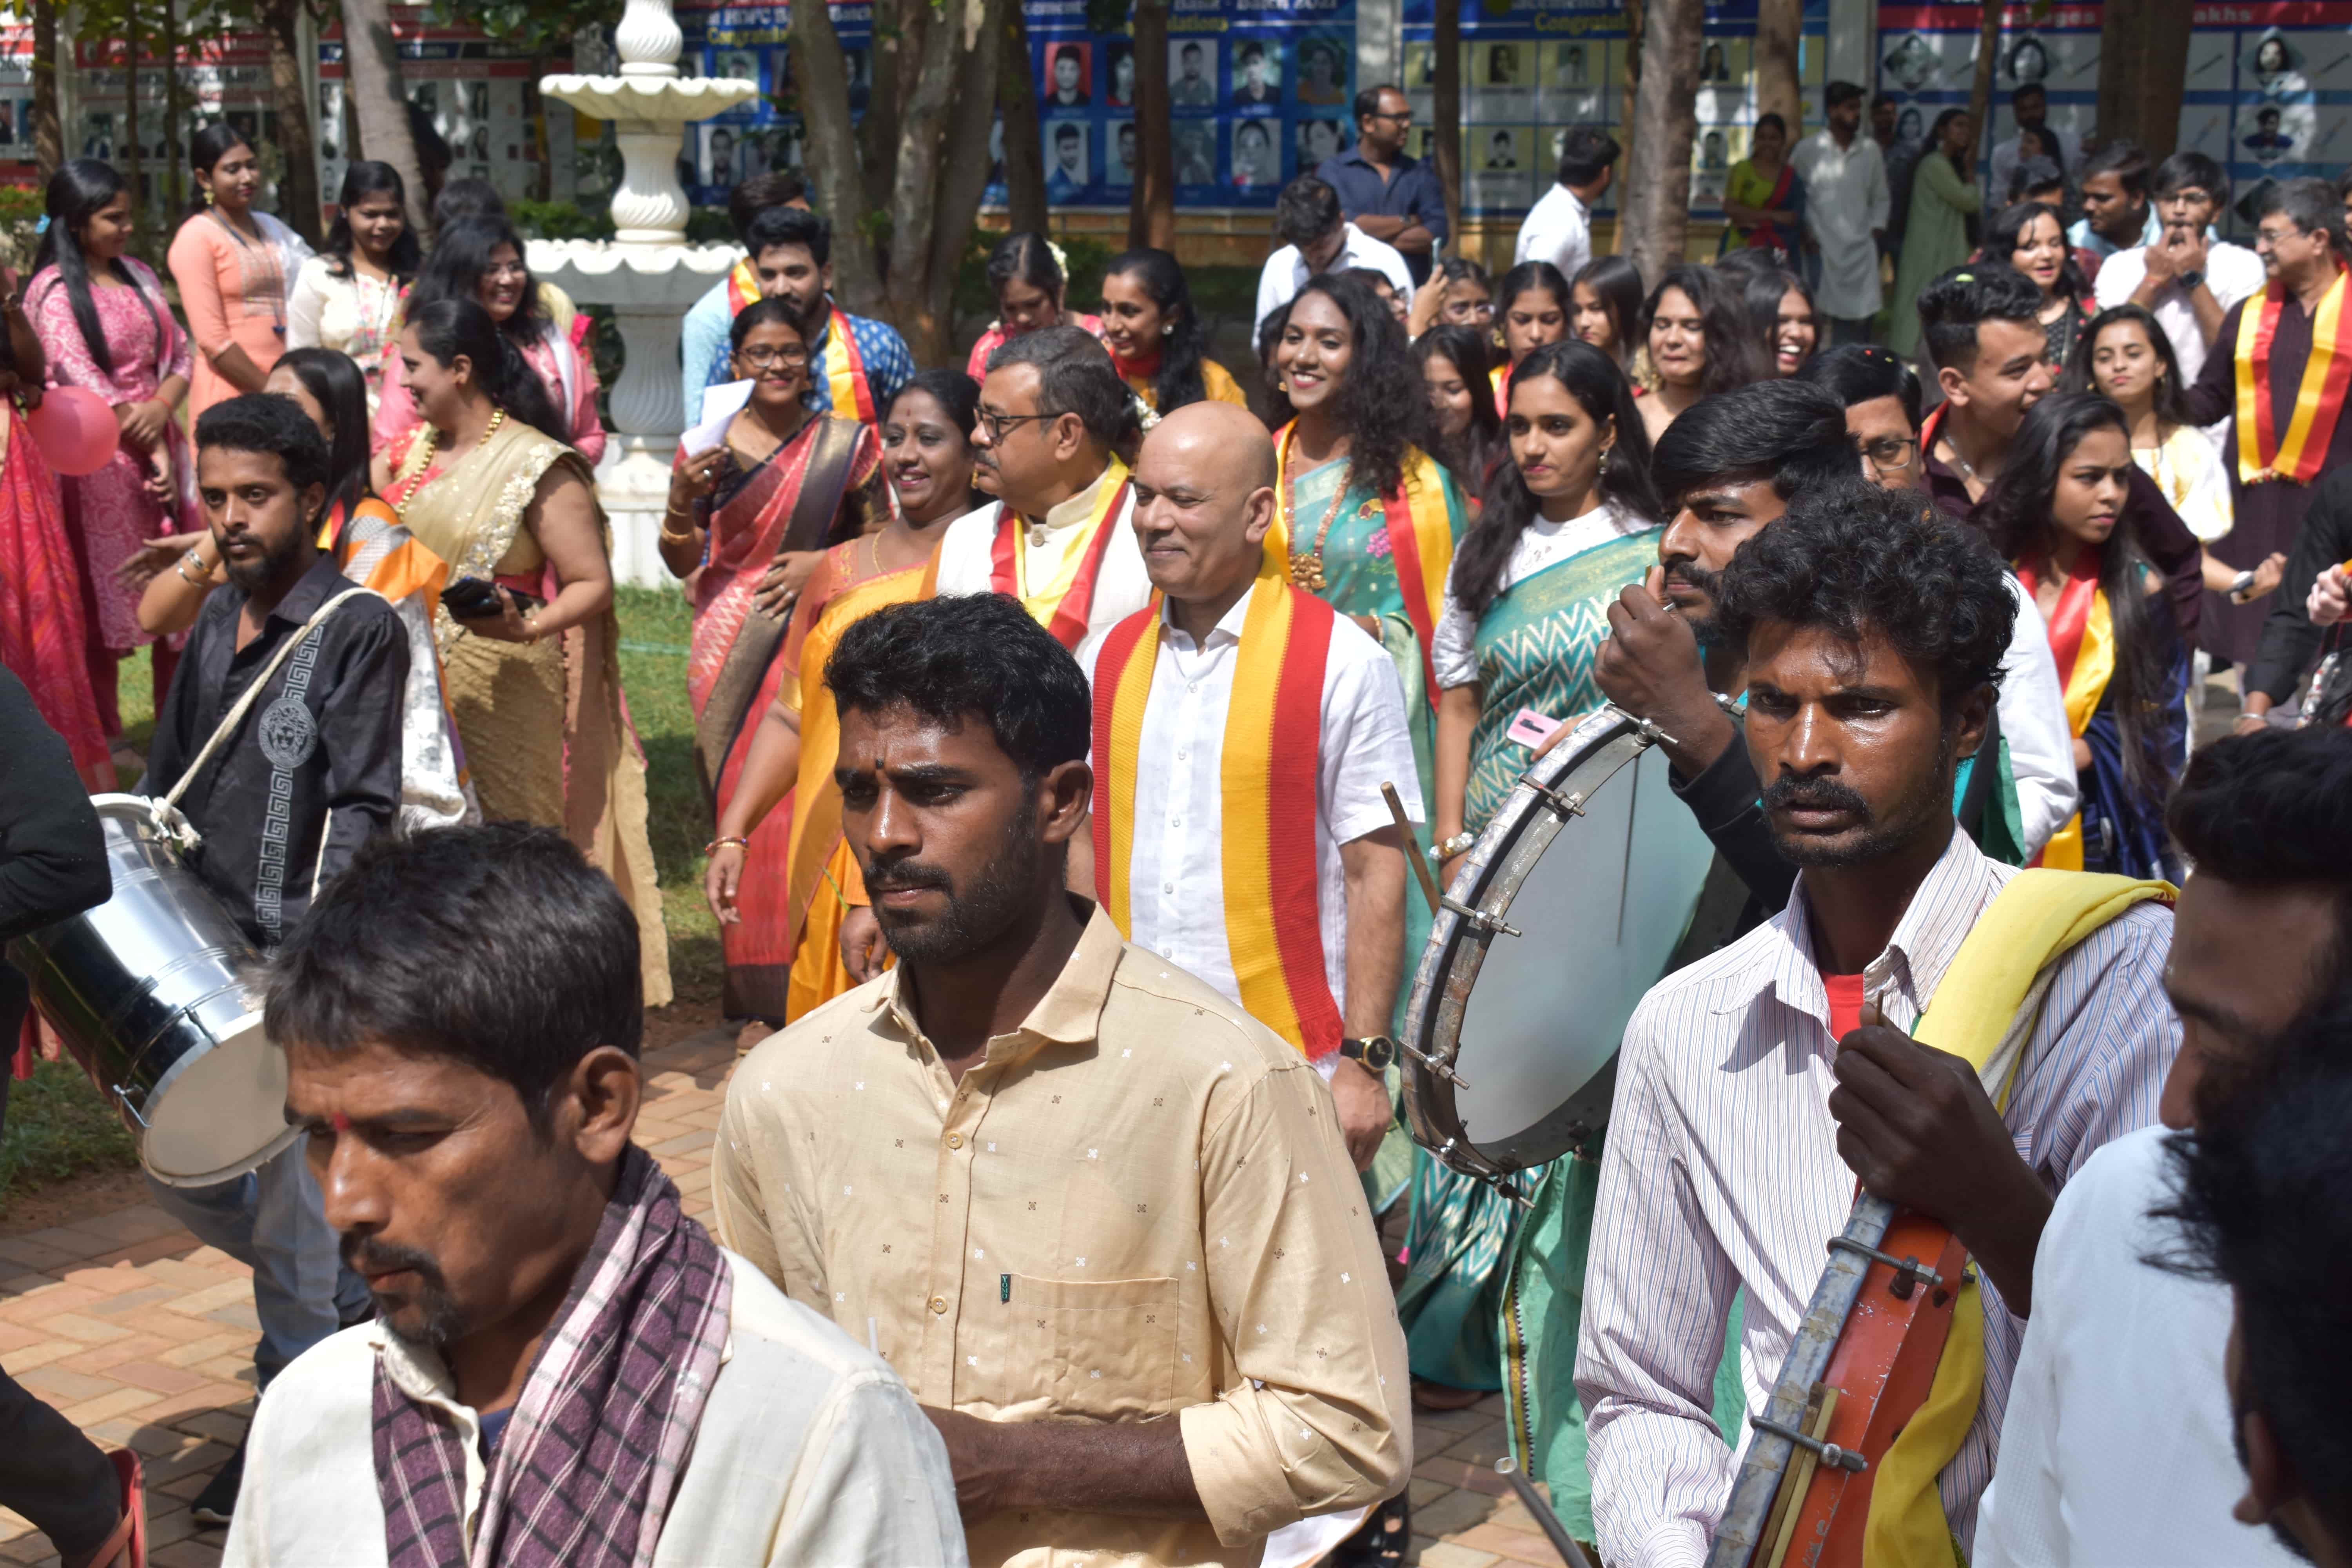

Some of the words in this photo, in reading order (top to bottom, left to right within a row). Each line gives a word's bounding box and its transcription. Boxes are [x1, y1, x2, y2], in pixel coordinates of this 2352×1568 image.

[1534, 12, 1627, 35] Congratul
[1997, 6, 2095, 27] ackages
[2193, 6, 2251, 23] akhs
